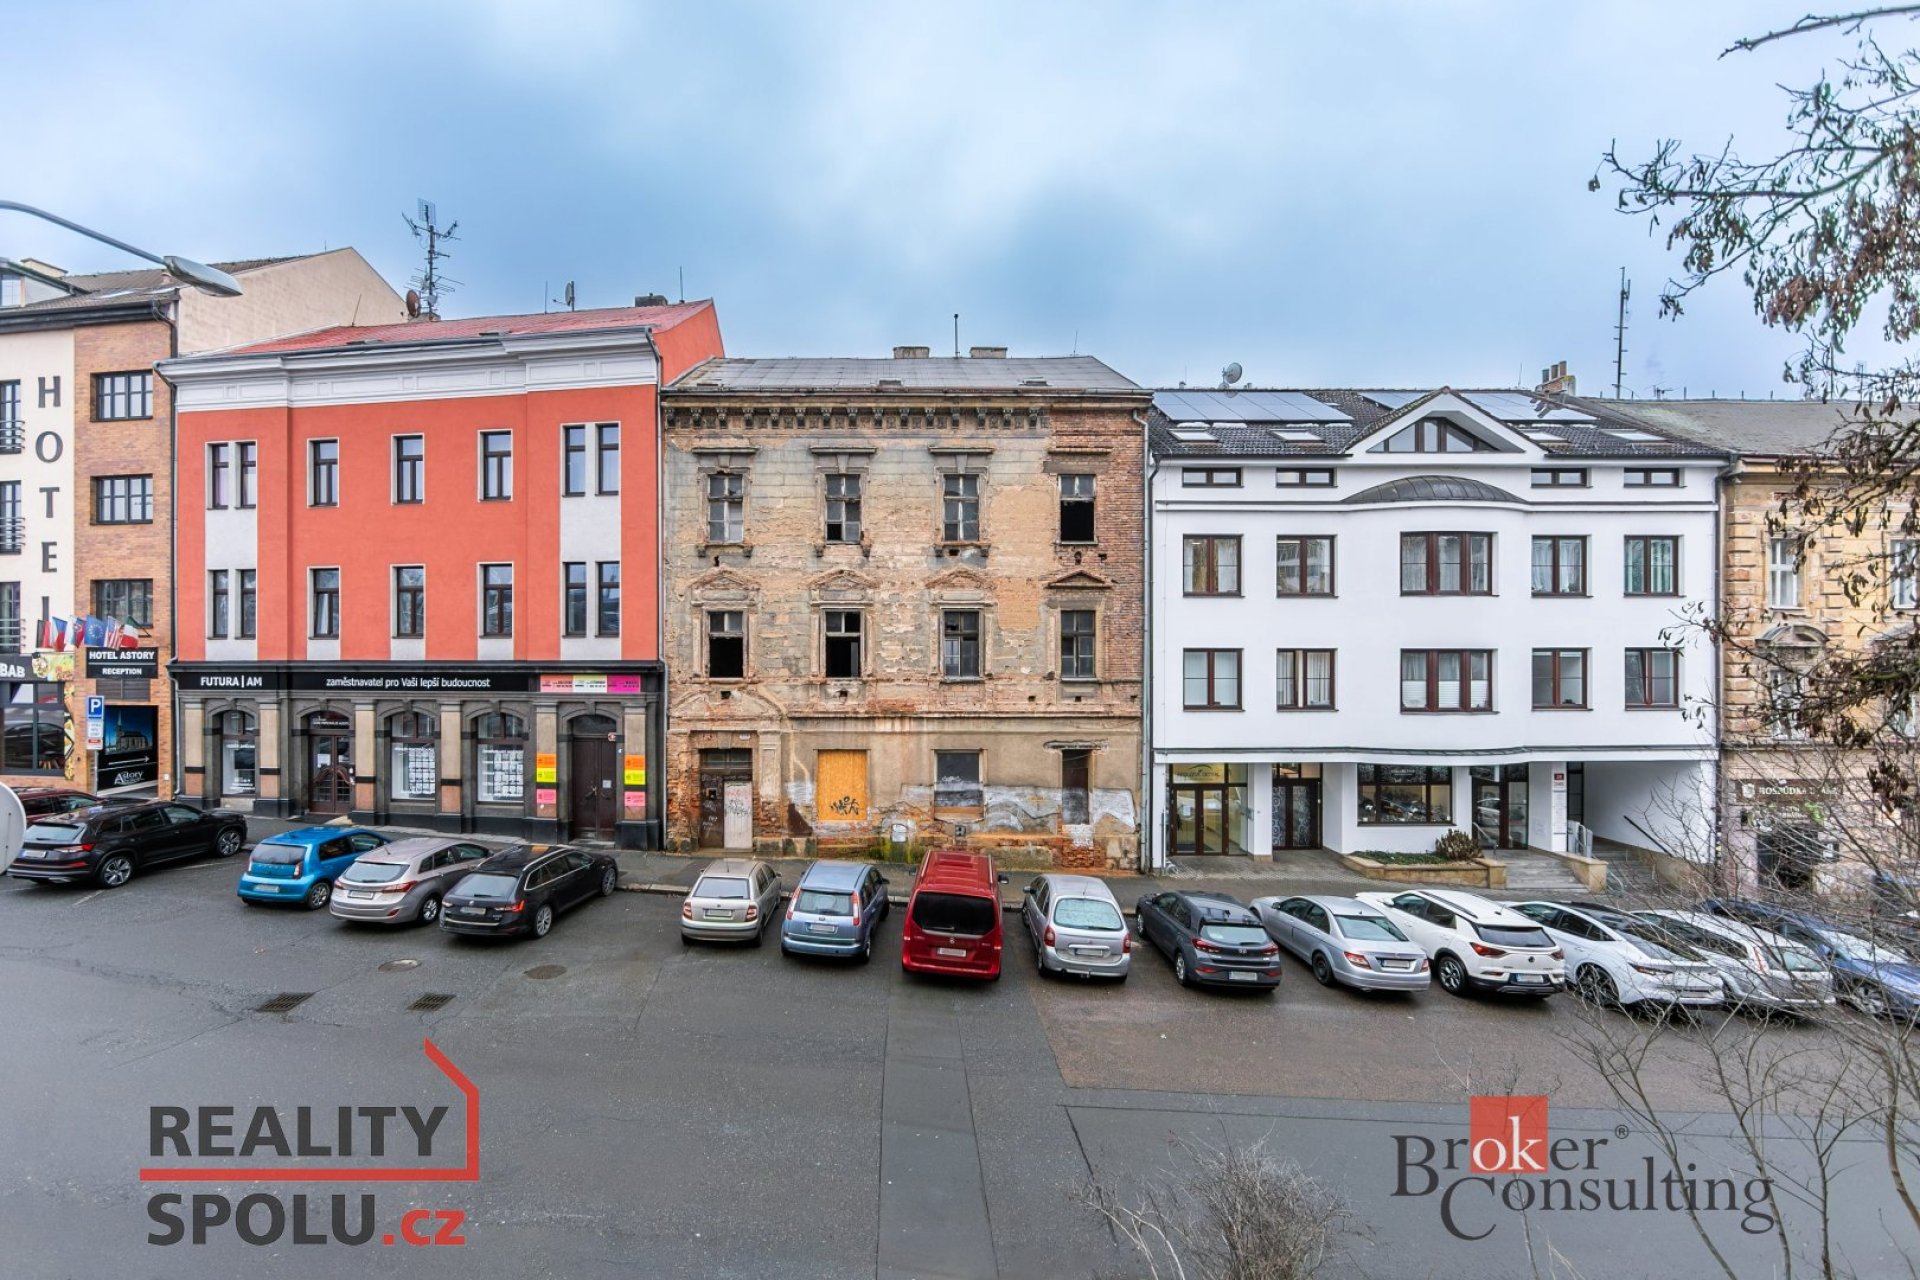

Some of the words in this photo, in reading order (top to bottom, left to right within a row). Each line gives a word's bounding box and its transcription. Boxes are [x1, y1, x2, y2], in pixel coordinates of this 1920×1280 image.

[89, 651, 118, 660] HOTEL
[120, 651, 155, 660] ASTORY
[102, 667, 143, 675] RECEPTION
[200, 676, 239, 686] FUTURA
[246, 676, 263, 686] AM
[326, 677, 384, 687] zaměstnavatel
[385, 679, 399, 689] pro
[401, 677, 418, 687] Vaši
[420, 677, 440, 689] lepší
[441, 677, 491, 688] budoucnost
[114, 771, 145, 785] Astory
